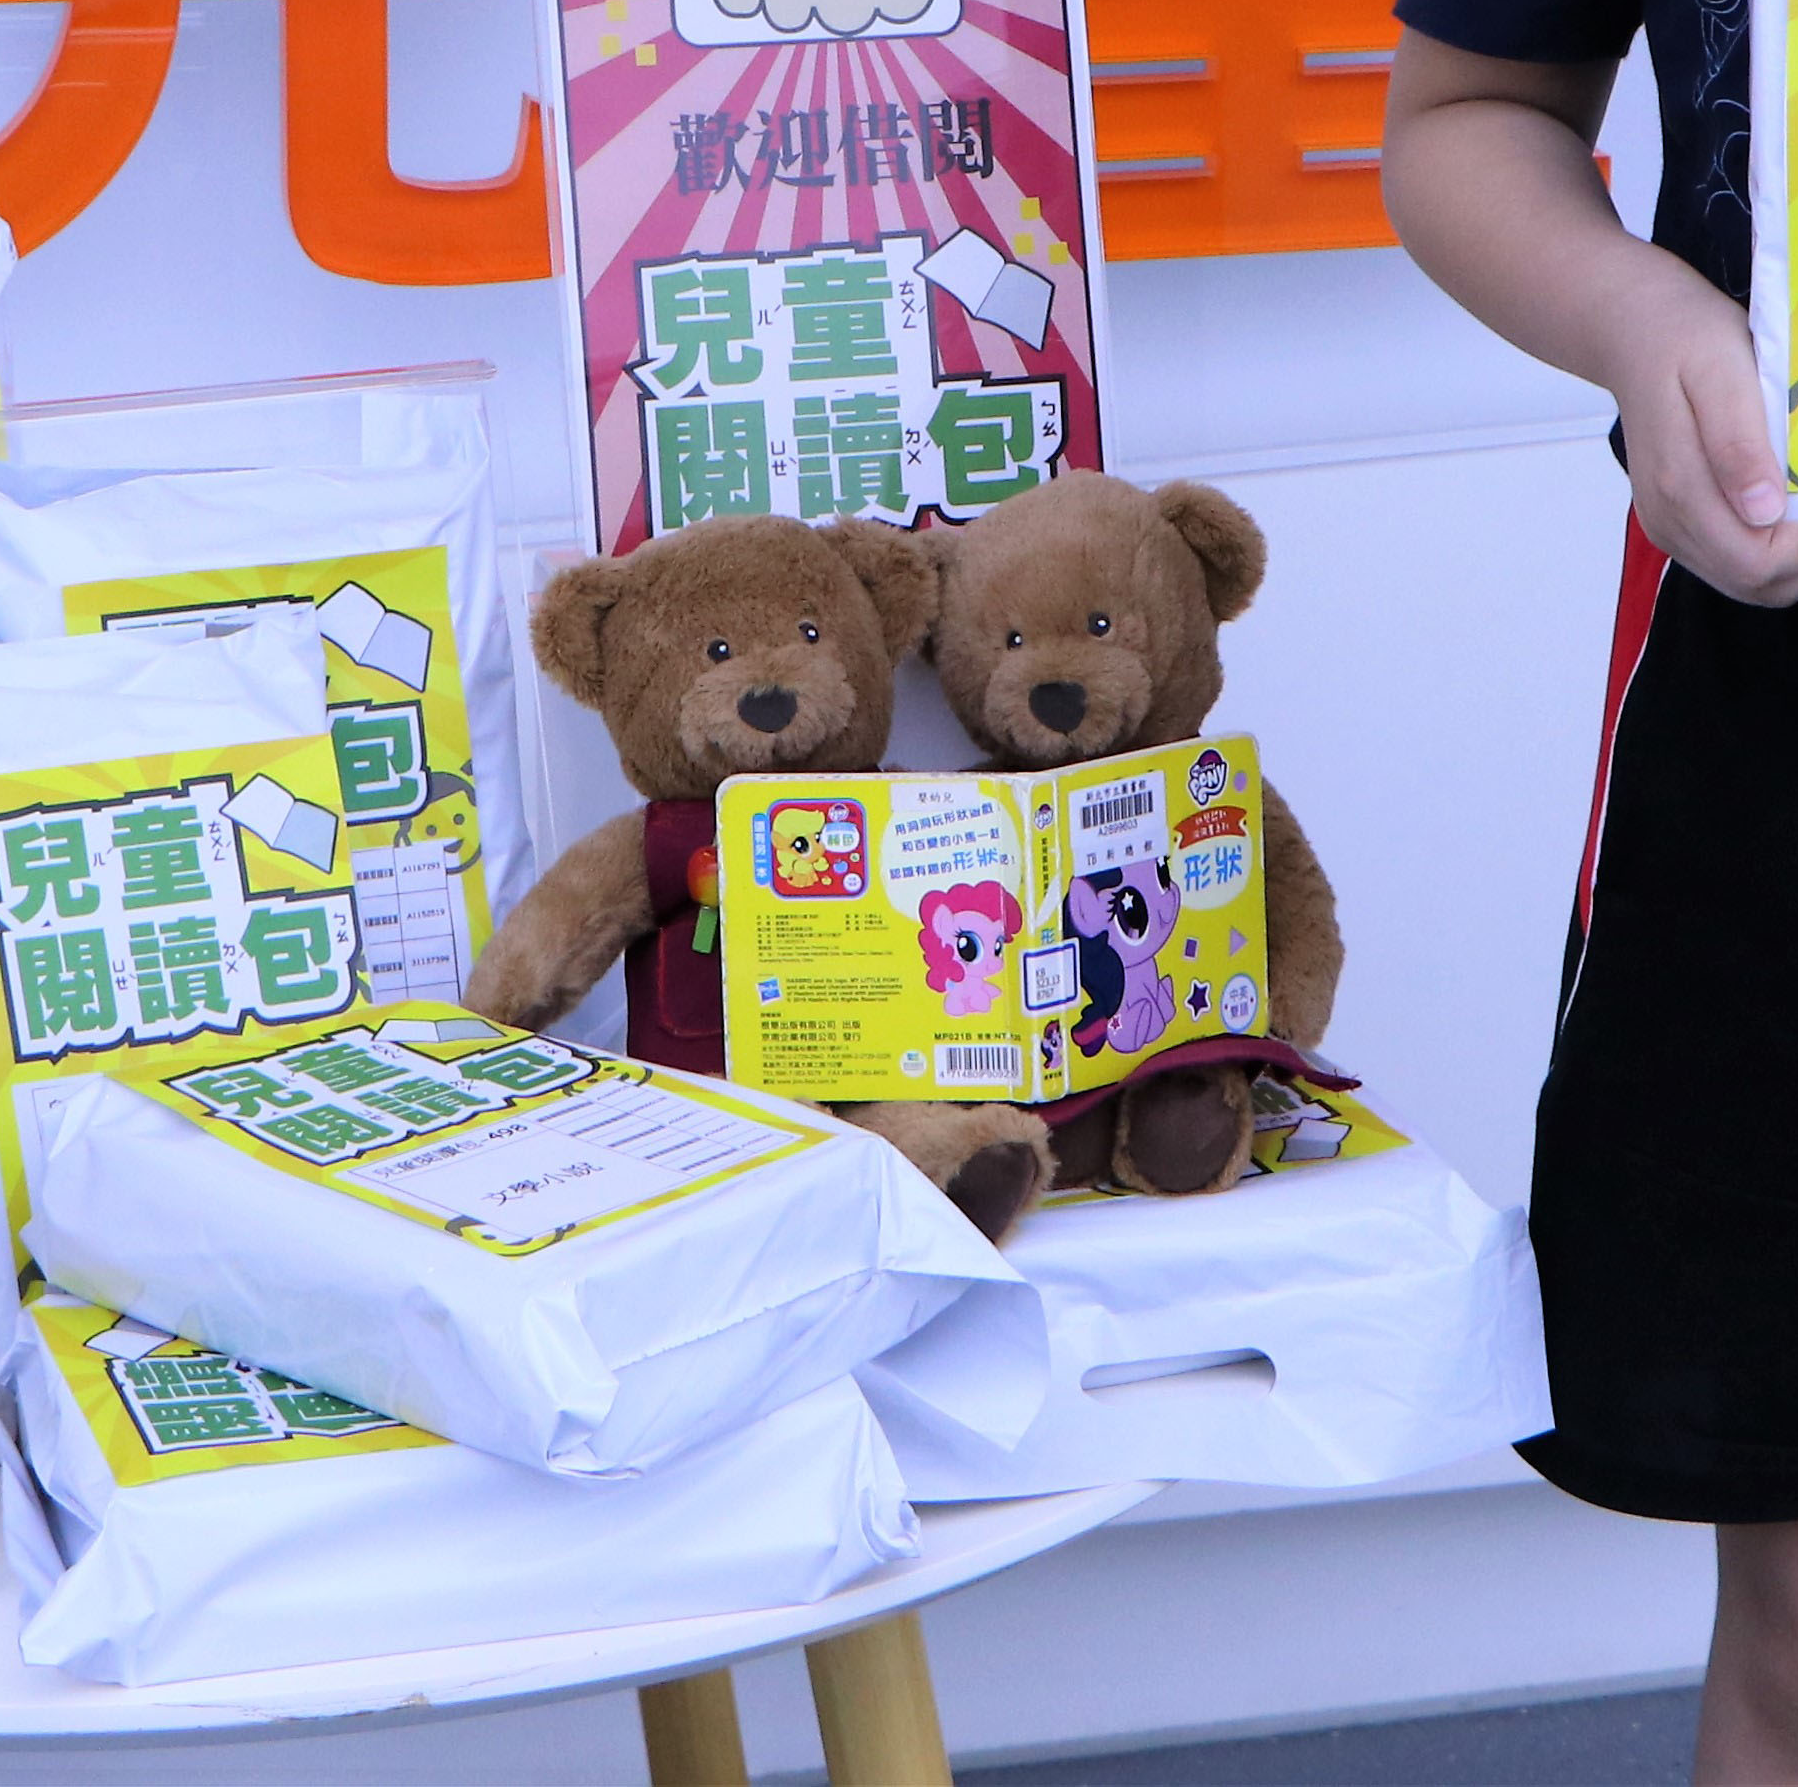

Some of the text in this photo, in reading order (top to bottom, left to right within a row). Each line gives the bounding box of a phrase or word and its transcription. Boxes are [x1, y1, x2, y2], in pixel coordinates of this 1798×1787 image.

[670, 97, 993, 197] 歡迎借閱
[651, 256, 901, 390] 兒童
[655, 389, 1041, 529] 閱讀包
[332, 715, 420, 813] 包
[3, 804, 213, 925] 兒童
[1184, 845, 1243, 892] 形狀
[15, 906, 340, 1041] 閱讀包
[184, 1042, 413, 1119] 兒童
[259, 1045, 581, 1157] 閱讀包
